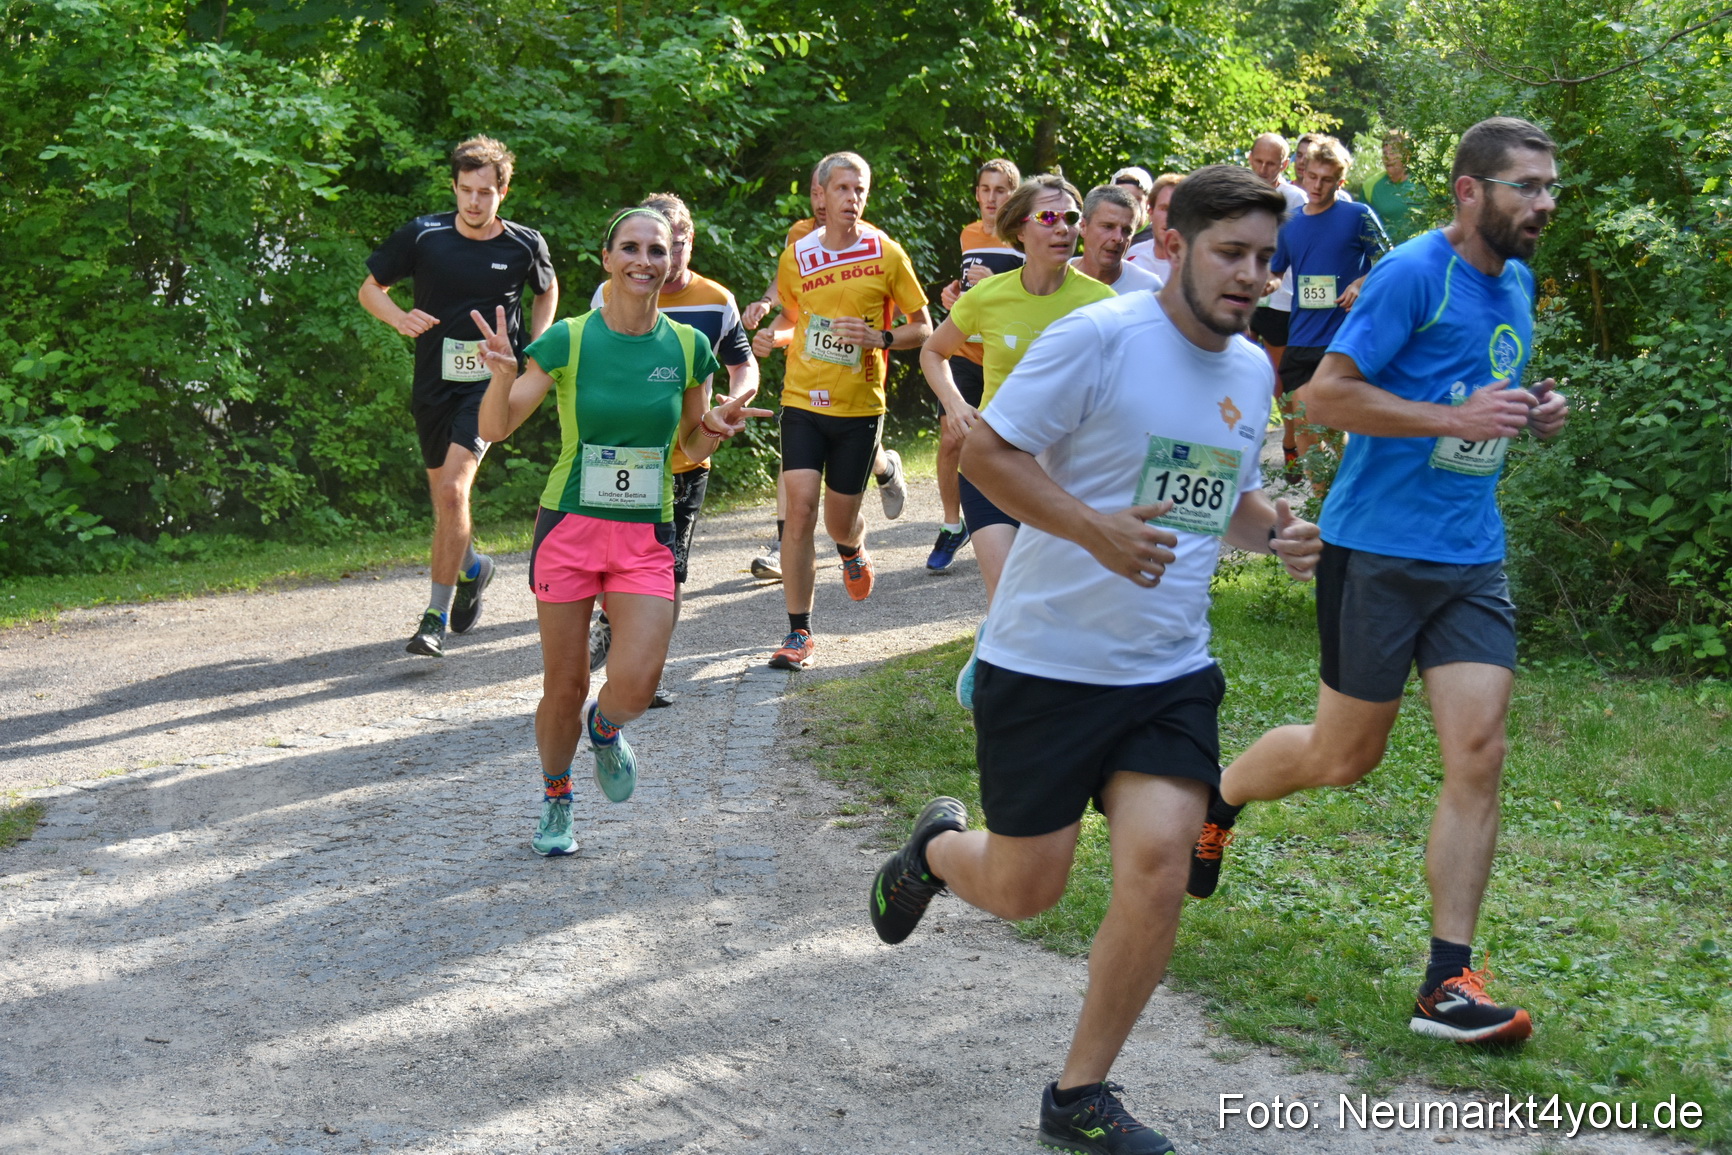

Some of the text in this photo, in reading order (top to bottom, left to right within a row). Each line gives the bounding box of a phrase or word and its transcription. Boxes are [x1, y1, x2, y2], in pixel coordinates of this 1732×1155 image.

[802, 265, 885, 293] MAX BÖGL
[1304, 287, 1326, 299] 853
[454, 355, 484, 370] 95
[648, 366, 680, 380] AOK
[615, 469, 630, 492] 8
[598, 490, 623, 498] Lindner
[1155, 470, 1225, 511] 1368
[1179, 506, 1212, 520] Christian
